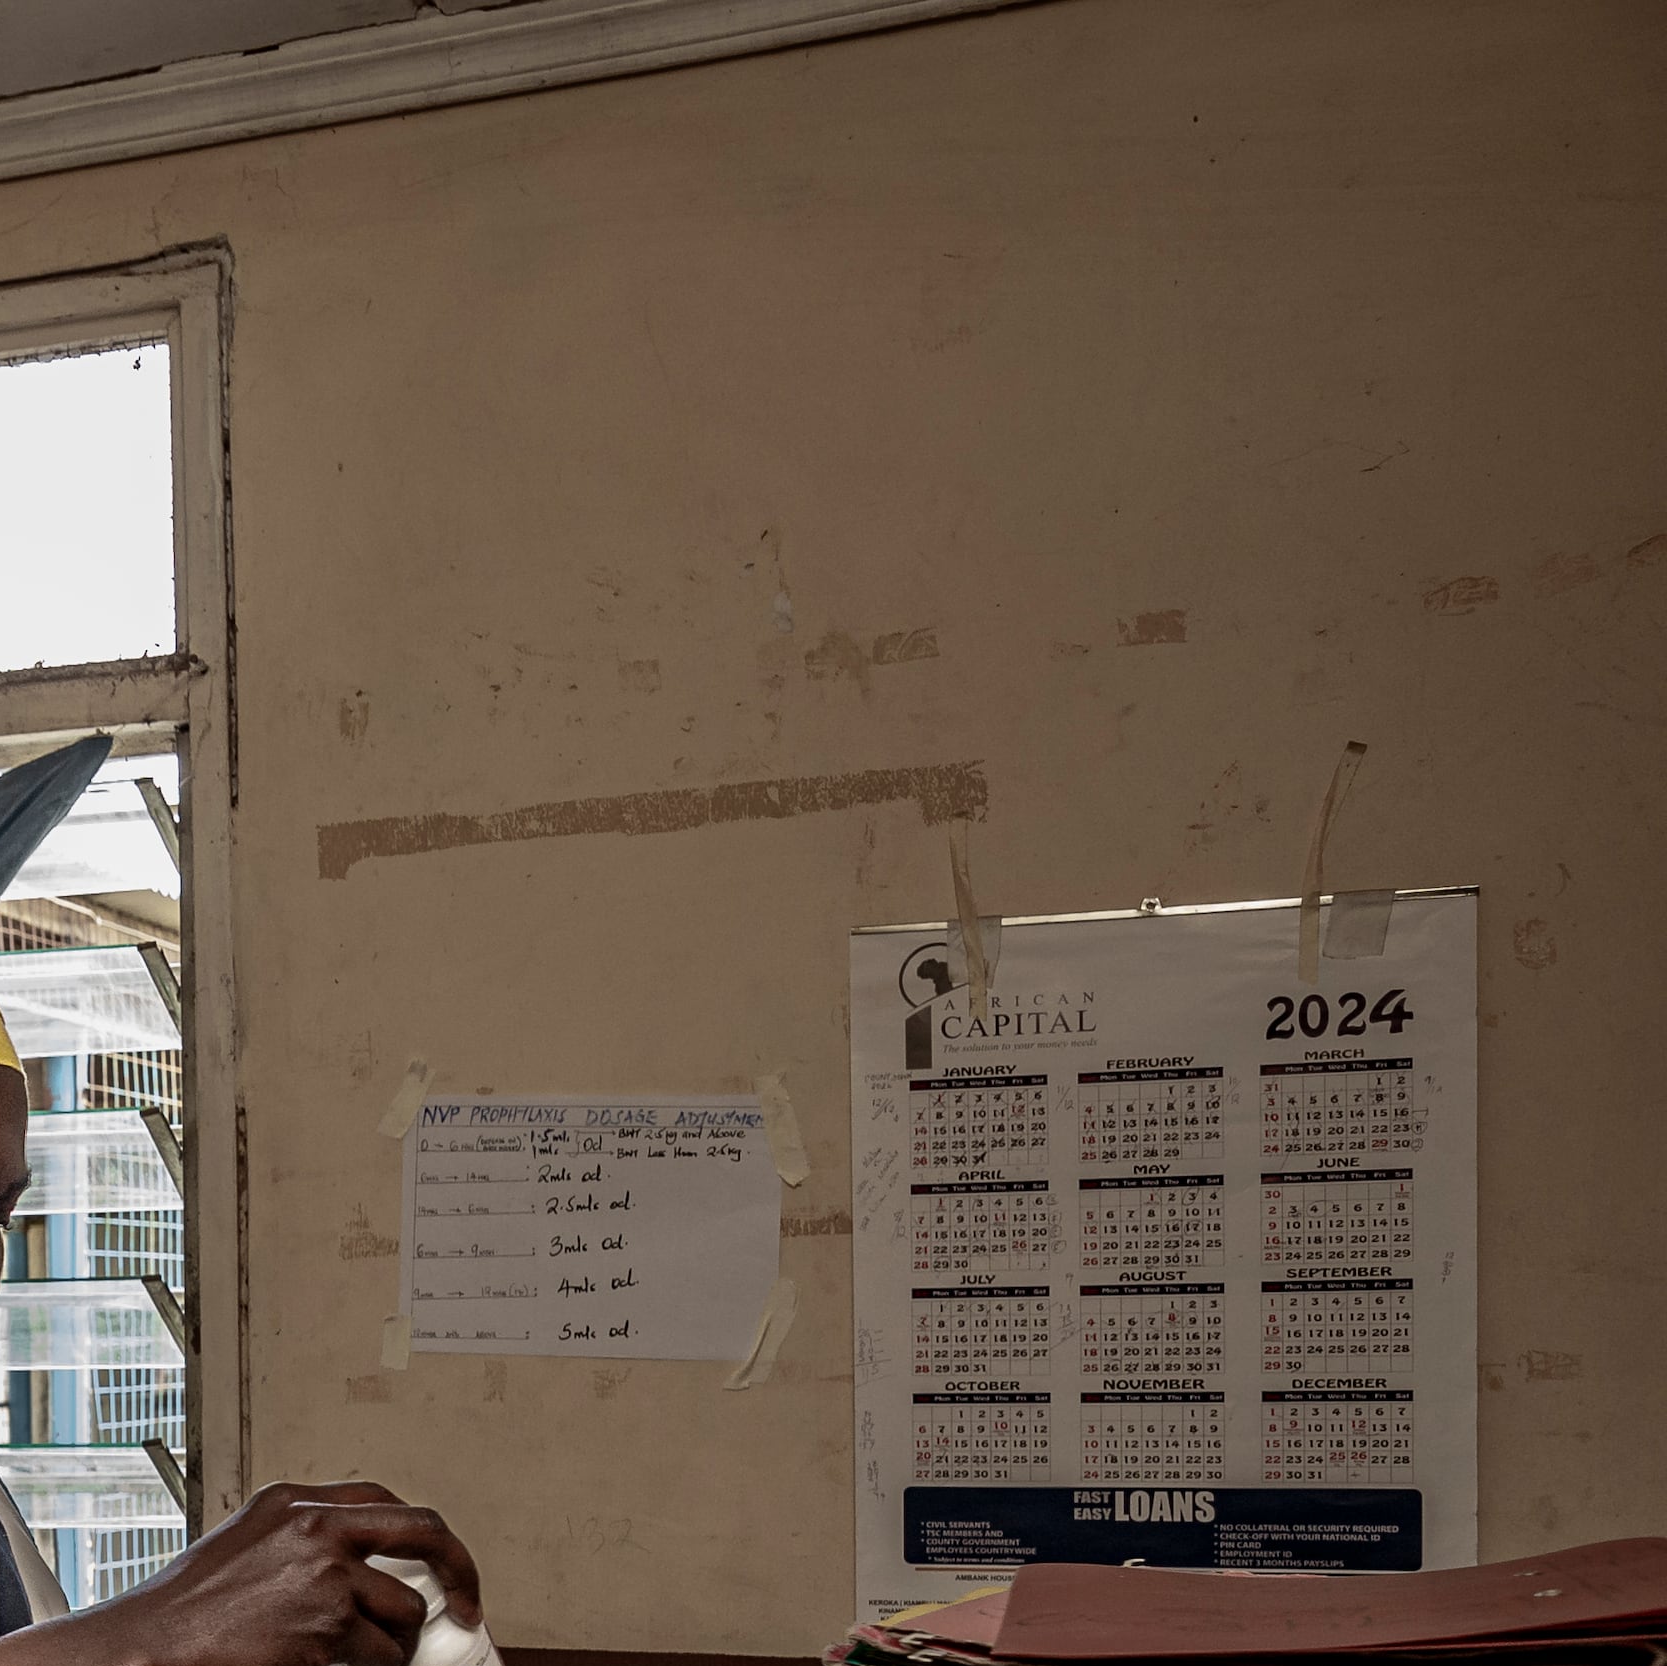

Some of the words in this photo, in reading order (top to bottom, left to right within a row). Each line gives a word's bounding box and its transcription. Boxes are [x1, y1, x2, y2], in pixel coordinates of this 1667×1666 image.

[945, 991, 1098, 1011] AFRICAN
[1266, 989, 1414, 1040] 2024
[940, 1010, 1097, 1040] CAPITAL
[943, 1044, 960, 1054] The
[962, 1043, 999, 1052] solution
[1001, 1043, 1011, 1051] to
[1037, 1041, 1067, 1051] money
[1304, 1048, 1365, 1061] MARCH
[1106, 1056, 1195, 1070] FEBRUARY
[942, 1065, 1017, 1078] JANUARY
[422, 1105, 461, 1128] NVP
[586, 1108, 658, 1126] DOSAGE
[1316, 1156, 1361, 1169] JUNE
[1133, 1163, 1171, 1175] MAY
[958, 1169, 1006, 1181] APRIL
[1118, 1270, 1187, 1282] AUGUST
[1286, 1266, 1393, 1279] SEPTEMBER
[959, 1274, 996, 1285] JULY
[945, 1380, 1020, 1391] OCTOBER
[1102, 1379, 1206, 1390] NOVEMBER
[1291, 1378, 1388, 1389] DECEMBER
[1264, 1471, 1282, 1480] 29
[1285, 1471, 1303, 1480] 30
[1306, 1471, 1322, 1480] 31
[1073, 1490, 1111, 1504] FAST
[1114, 1490, 1216, 1523] LOANS
[1073, 1507, 1112, 1521] EASY
[926, 1521, 947, 1530] CIVIL
[948, 1521, 992, 1530] SERVANTS
[1219, 1524, 1234, 1532] NO
[1235, 1524, 1290, 1533] COLLATERAL
[1292, 1524, 1306, 1533] OR
[1307, 1524, 1351, 1533] SECURITY
[1352, 1525, 1400, 1533] REQUIRED
[926, 1530, 939, 1538] TSC
[940, 1530, 984, 1539] MEMBERS
[985, 1530, 1004, 1539] AND
[1219, 1532, 1269, 1541] CHECK-OFF
[1270, 1533, 1294, 1541] WITH
[1295, 1533, 1320, 1541] YOUR
[1322, 1534, 1369, 1542] NATIONAL
[1370, 1534, 1381, 1542] ID
[926, 1538, 961, 1548] COUNTY
[962, 1538, 1021, 1548] GOVERNMENT
[1219, 1541, 1235, 1549] PIN
[1236, 1541, 1262, 1550] CARD
[926, 1547, 974, 1556] EMPLOYEES
[975, 1547, 1037, 1556] COUNTRYWIDE
[1219, 1550, 1281, 1559] EMPLOYMENT
[1282, 1551, 1293, 1559] ID
[1219, 1558, 1254, 1567] RECENT
[1262, 1559, 1302, 1568] MONTHS
[1303, 1560, 1345, 1568] PAYSLIPS
[955, 1574, 989, 1582] AMBANK
